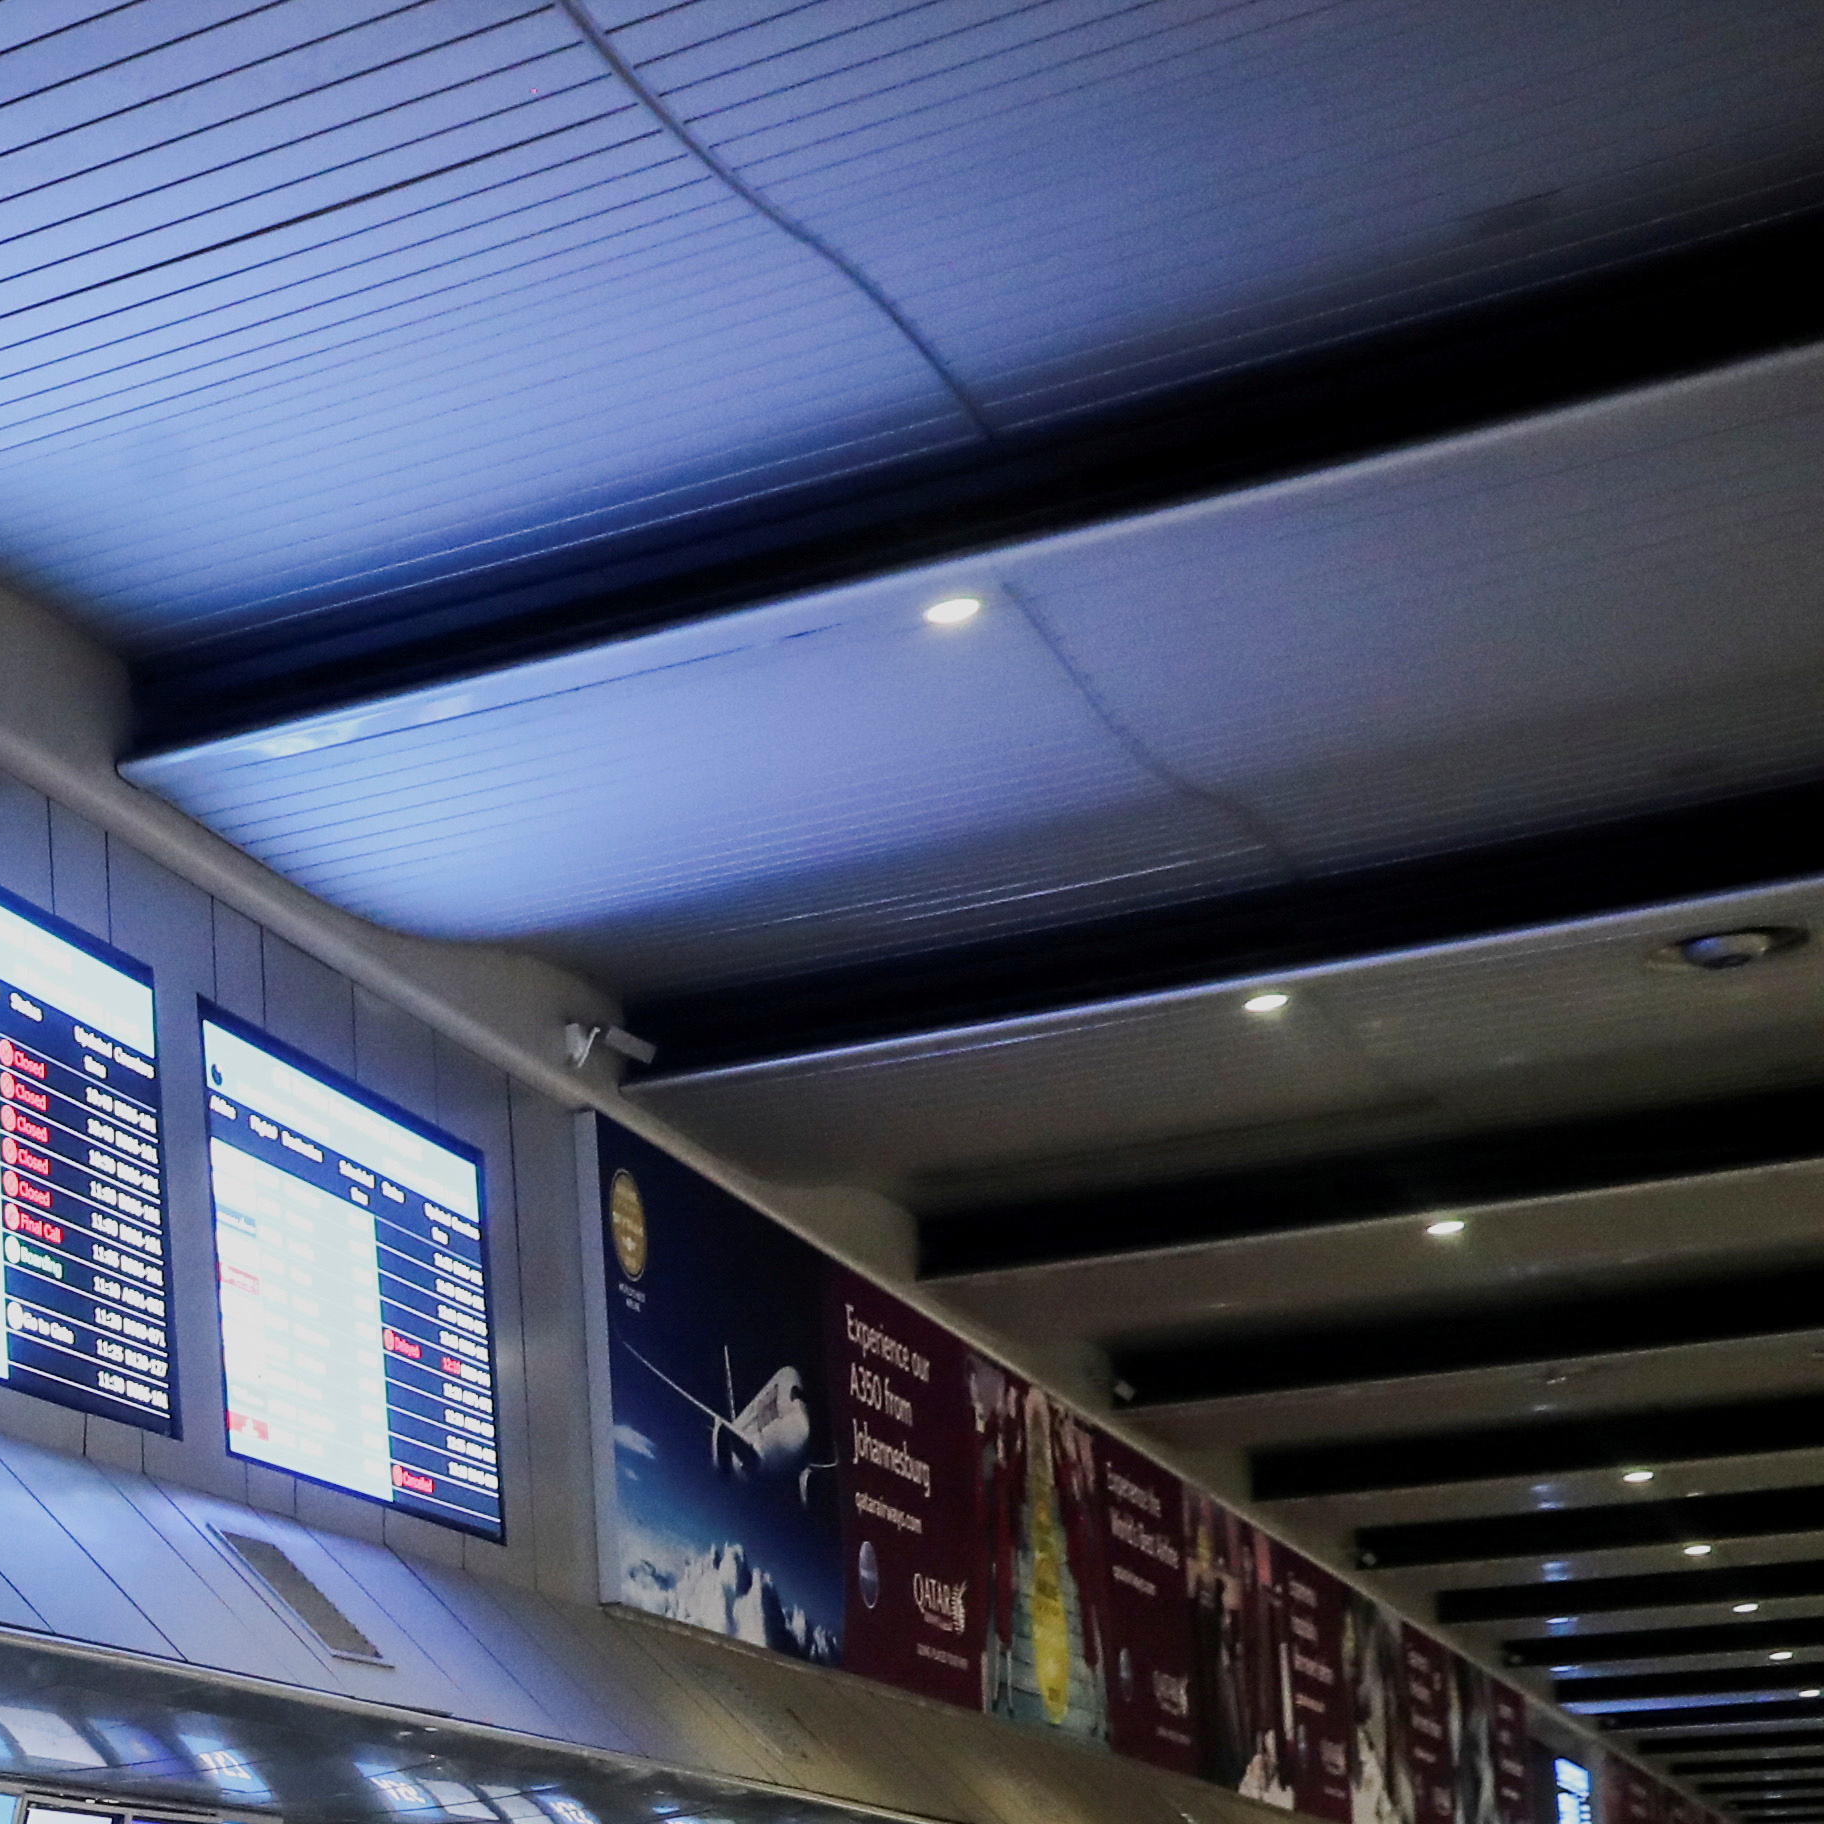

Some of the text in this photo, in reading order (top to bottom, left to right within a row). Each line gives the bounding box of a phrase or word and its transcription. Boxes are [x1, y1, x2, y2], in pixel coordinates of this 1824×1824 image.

[14, 1052, 46, 1079] Closed
[16, 1083, 48, 1111] Closed
[17, 1115, 49, 1143] Closed
[18, 1148, 50, 1175] Closed
[19, 1180, 51, 1207] Closed
[20, 1213, 63, 1244] Final Call
[846, 1303, 910, 1373] Experience
[850, 1362, 913, 1427] A350 from
[852, 1418, 931, 1498] Johannesburg
